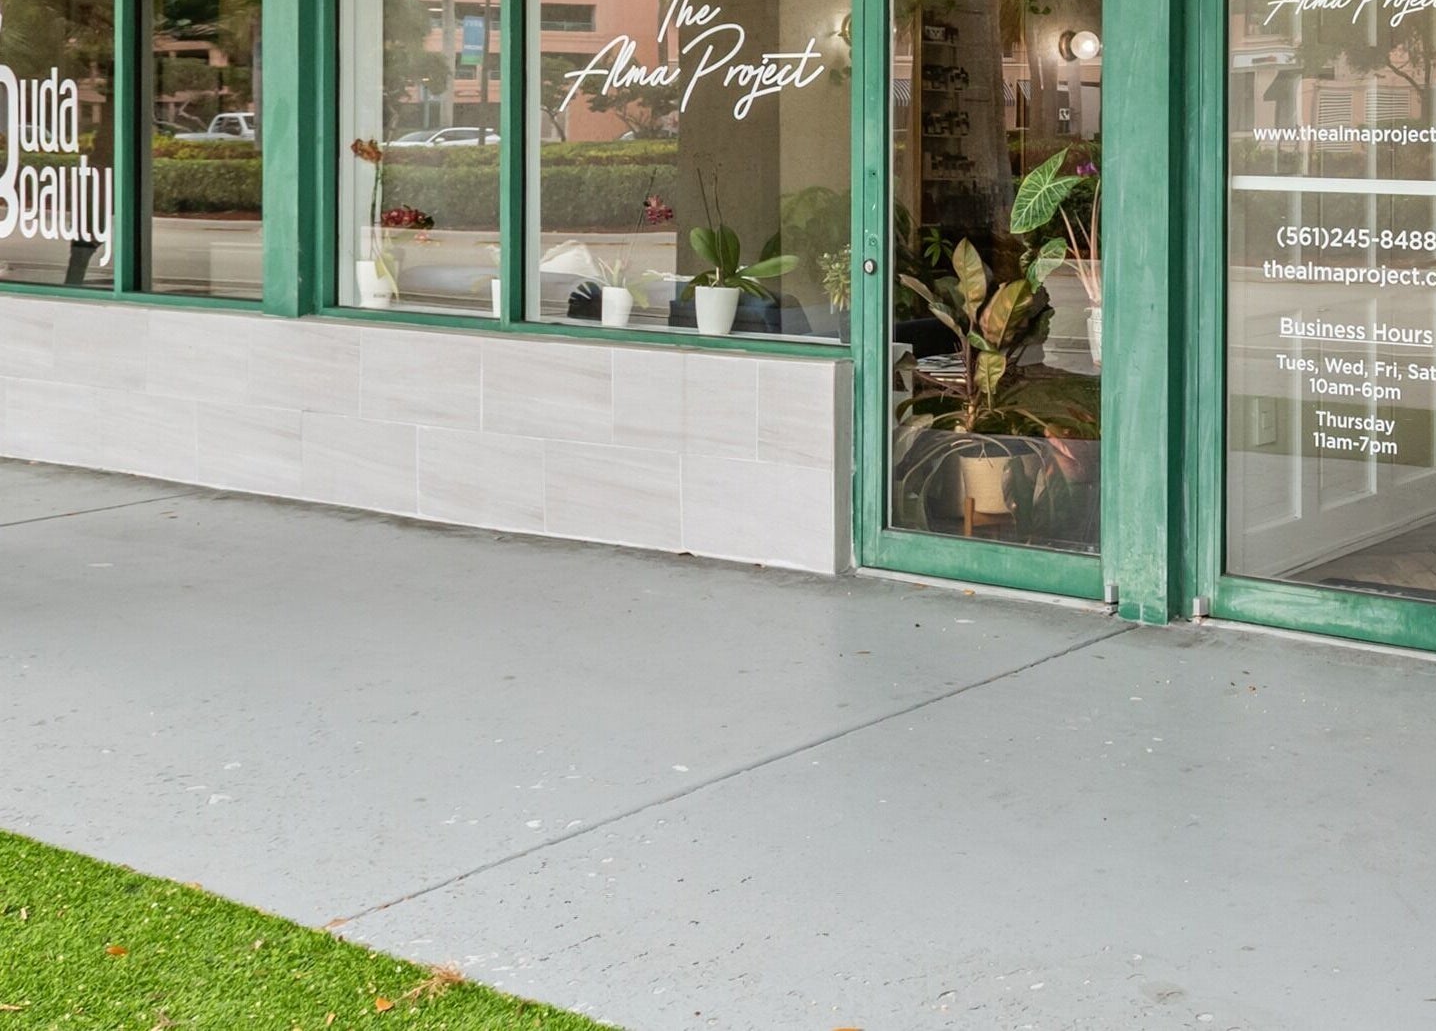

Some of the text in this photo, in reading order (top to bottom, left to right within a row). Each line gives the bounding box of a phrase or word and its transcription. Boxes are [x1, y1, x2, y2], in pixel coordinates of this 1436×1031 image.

[559, 23, 825, 121] Alma Project
[1279, 317, 1434, 344] Business Hours
[1276, 354, 1436, 381] Tues, Wed, Fri, Sat
[1309, 378, 1401, 401] 10am-6pm
[1316, 411, 1396, 434] Thursday
[1313, 432, 1398, 456] 11am-7pm
